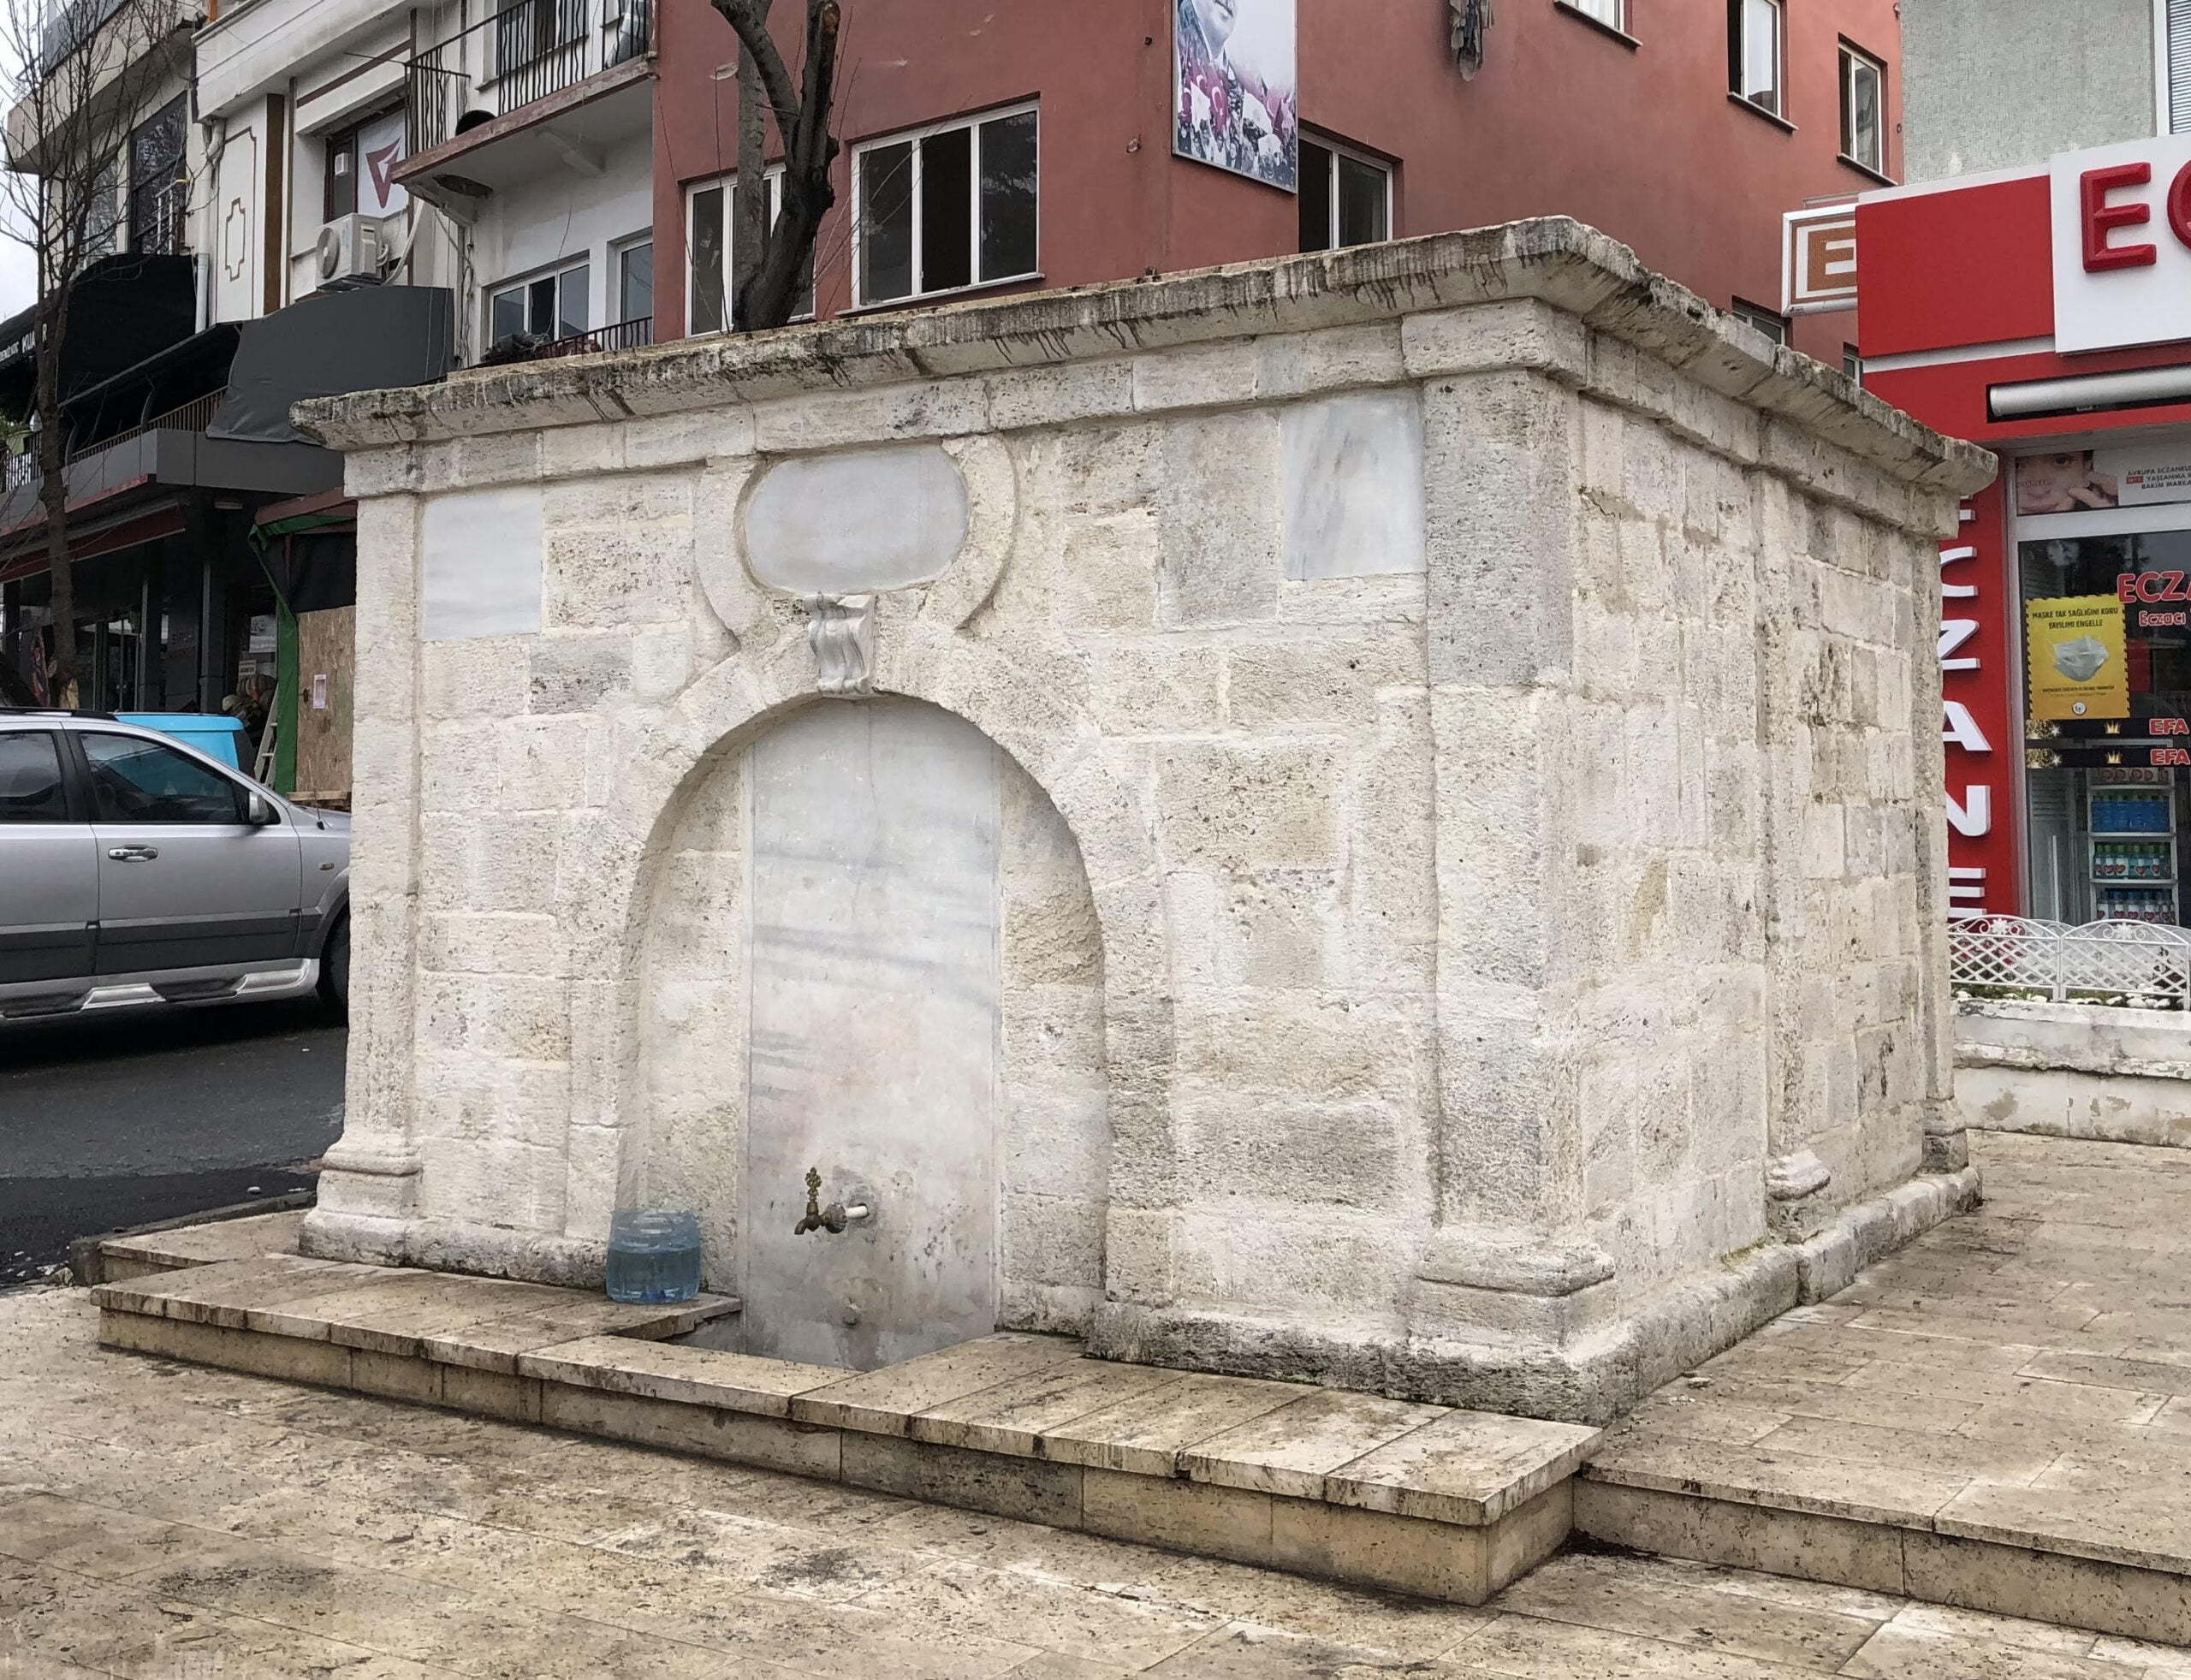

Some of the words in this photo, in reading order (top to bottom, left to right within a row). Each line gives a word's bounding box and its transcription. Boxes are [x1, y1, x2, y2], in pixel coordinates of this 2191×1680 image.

[21, 323, 47, 353] KUAR
[2055, 609, 2067, 618] TAK
[2100, 607, 2118, 615] KORU
[2149, 717, 2190, 735] EFA
[2150, 748, 2191, 765] EFA
